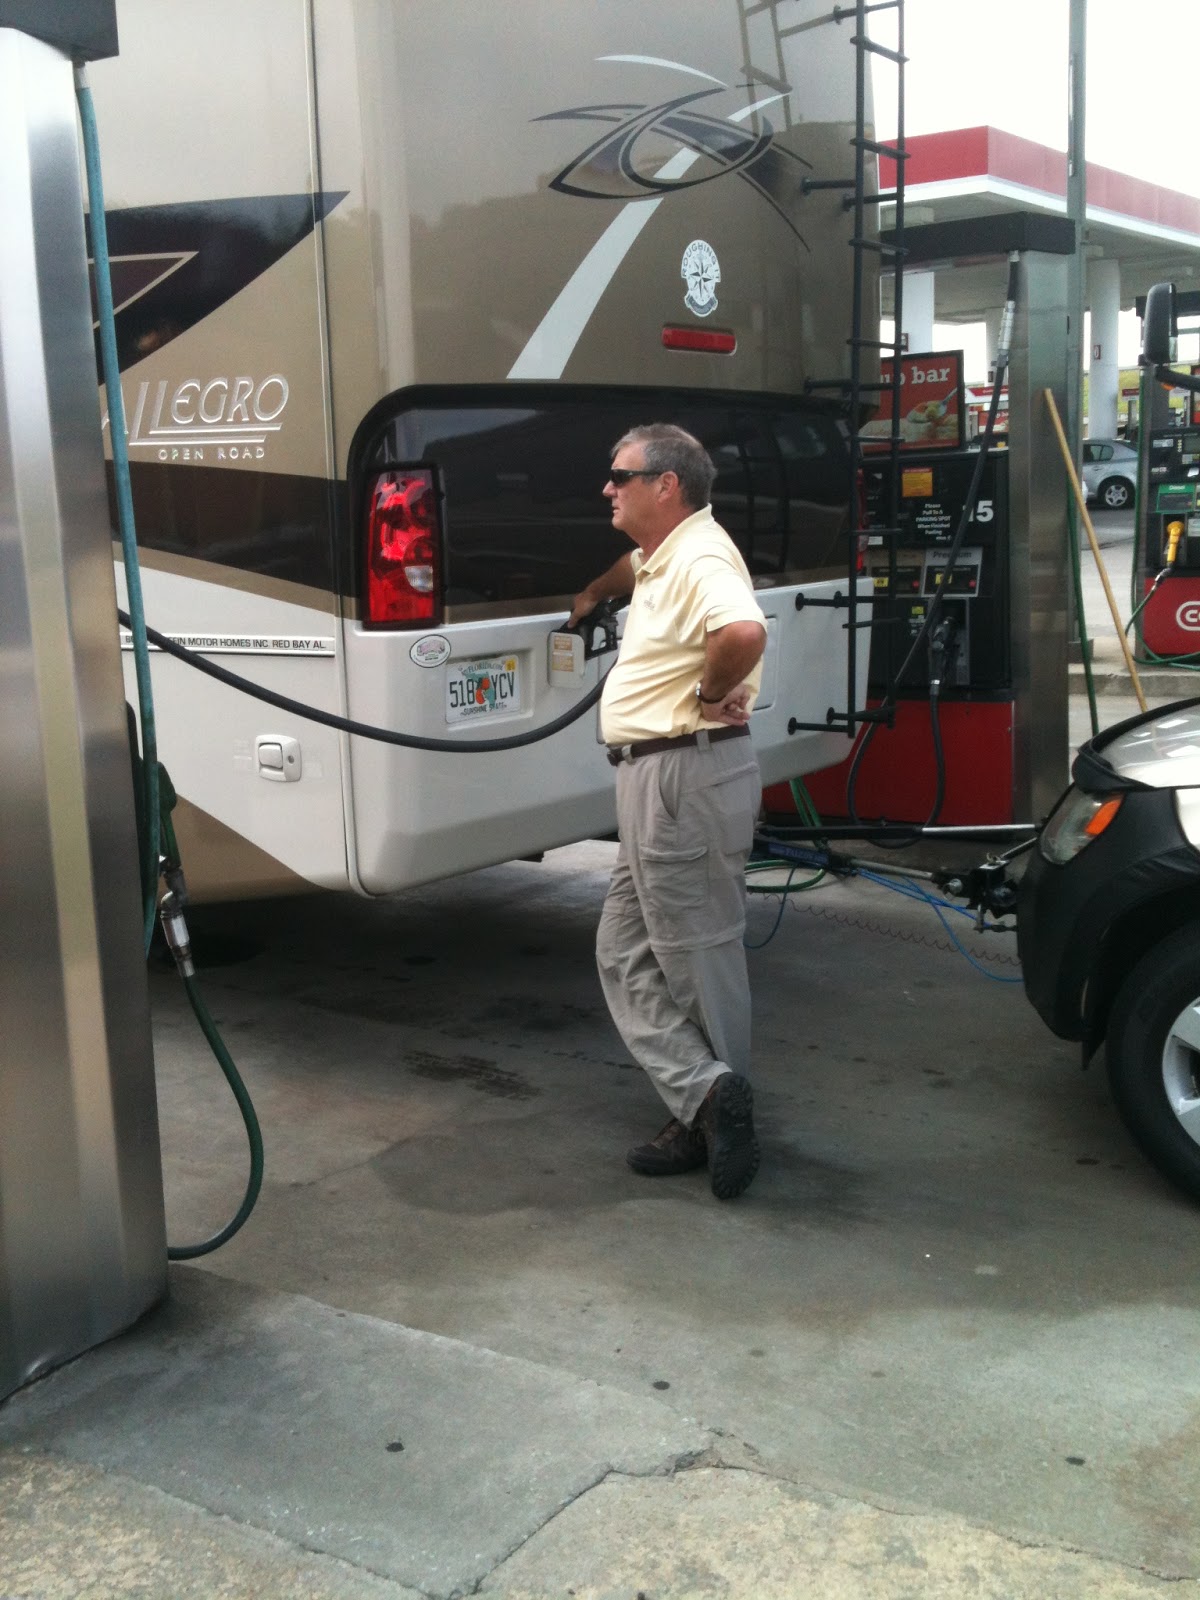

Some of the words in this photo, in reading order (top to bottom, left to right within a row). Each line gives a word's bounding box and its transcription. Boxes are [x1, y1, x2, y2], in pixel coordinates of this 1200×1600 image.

[911, 366, 951, 384] bar
[103, 373, 290, 446] LLEGRO
[157, 447, 204, 461] OPEN
[217, 446, 265, 460] ROAD
[932, 550, 972, 559] Preum
[187, 637, 218, 647] MOTOR
[219, 638, 252, 648] HOMES
[272, 639, 291, 649] RED
[292, 639, 311, 649] BAY
[449, 678, 476, 708] 518
[490, 671, 515, 700] YCV
[463, 704, 488, 716] SUNSHINE
